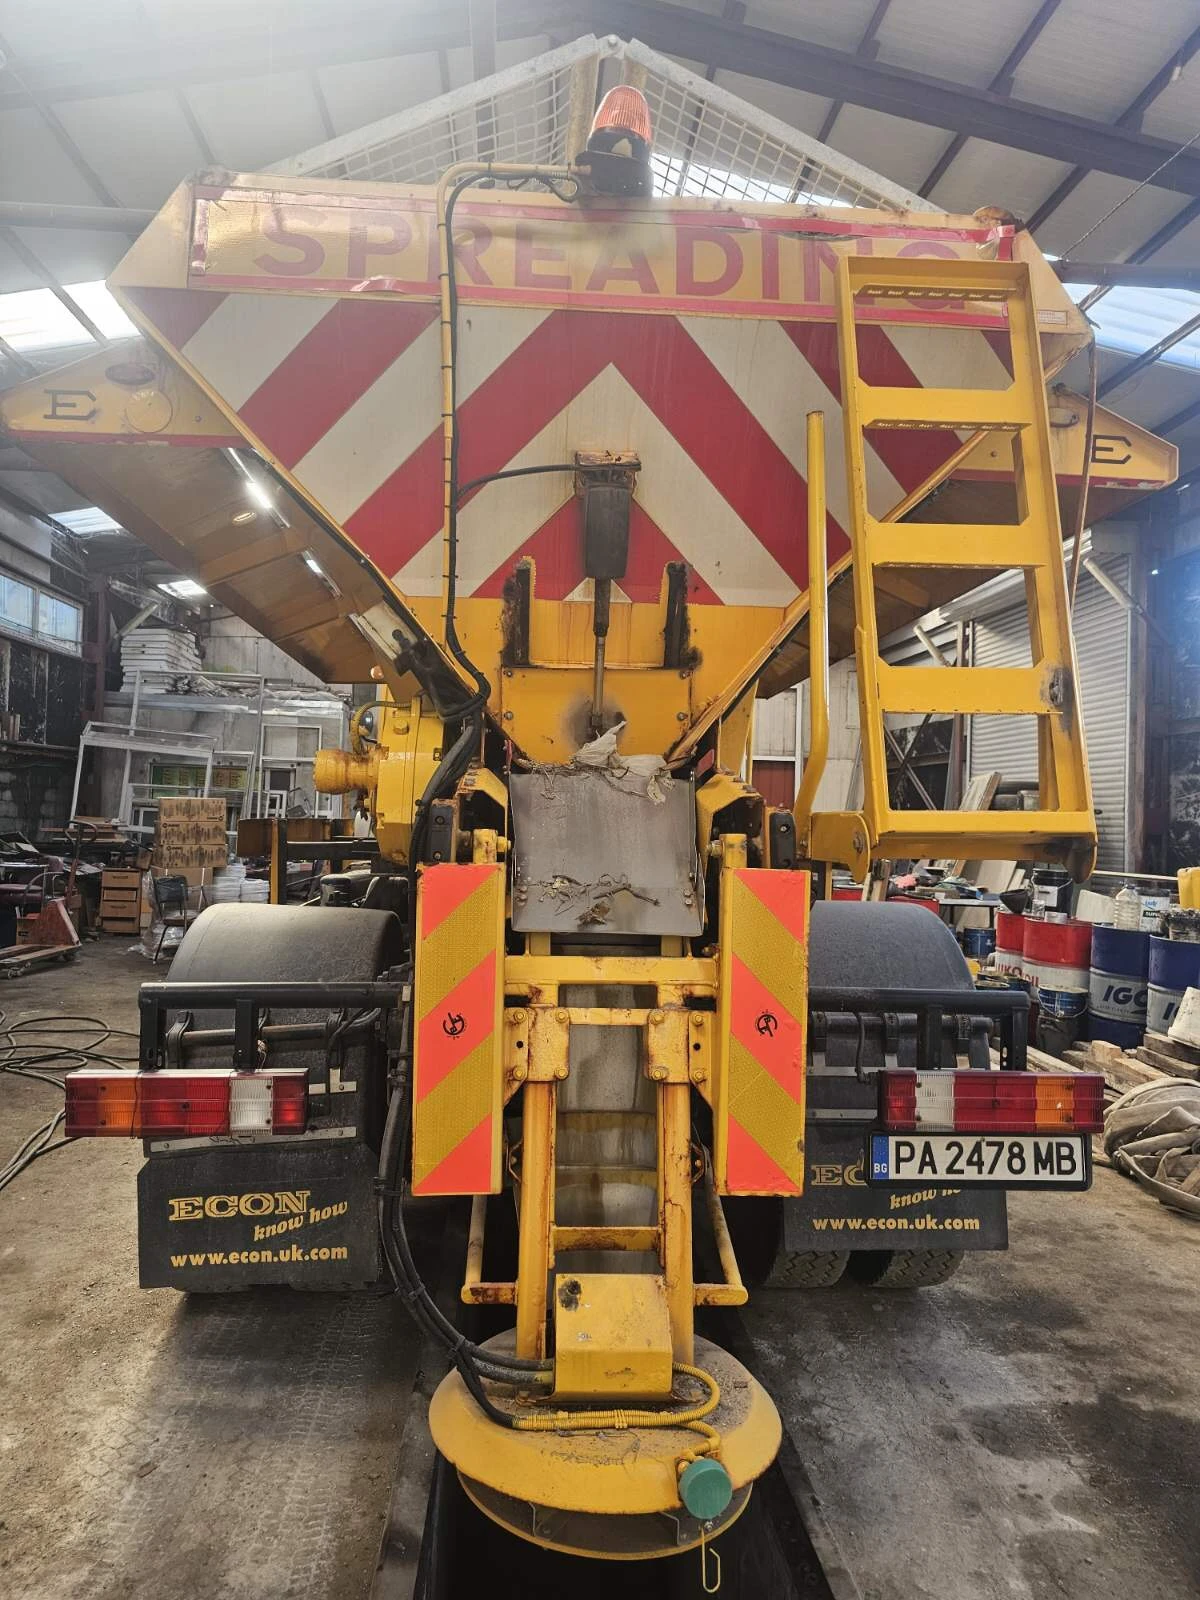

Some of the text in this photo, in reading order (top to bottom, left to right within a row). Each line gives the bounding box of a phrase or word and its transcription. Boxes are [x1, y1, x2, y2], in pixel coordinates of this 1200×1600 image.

[873, 1162, 888, 1173] BG
[894, 1141, 1077, 1176] PA 2478 MB
[811, 1164, 869, 1186] EC
[168, 1190, 311, 1221] ECON
[890, 1189, 937, 1210] know
[254, 1201, 348, 1241] know how
[813, 1214, 980, 1231] www.econ.uk.com
[170, 1244, 348, 1268] www.econ.uk.com
